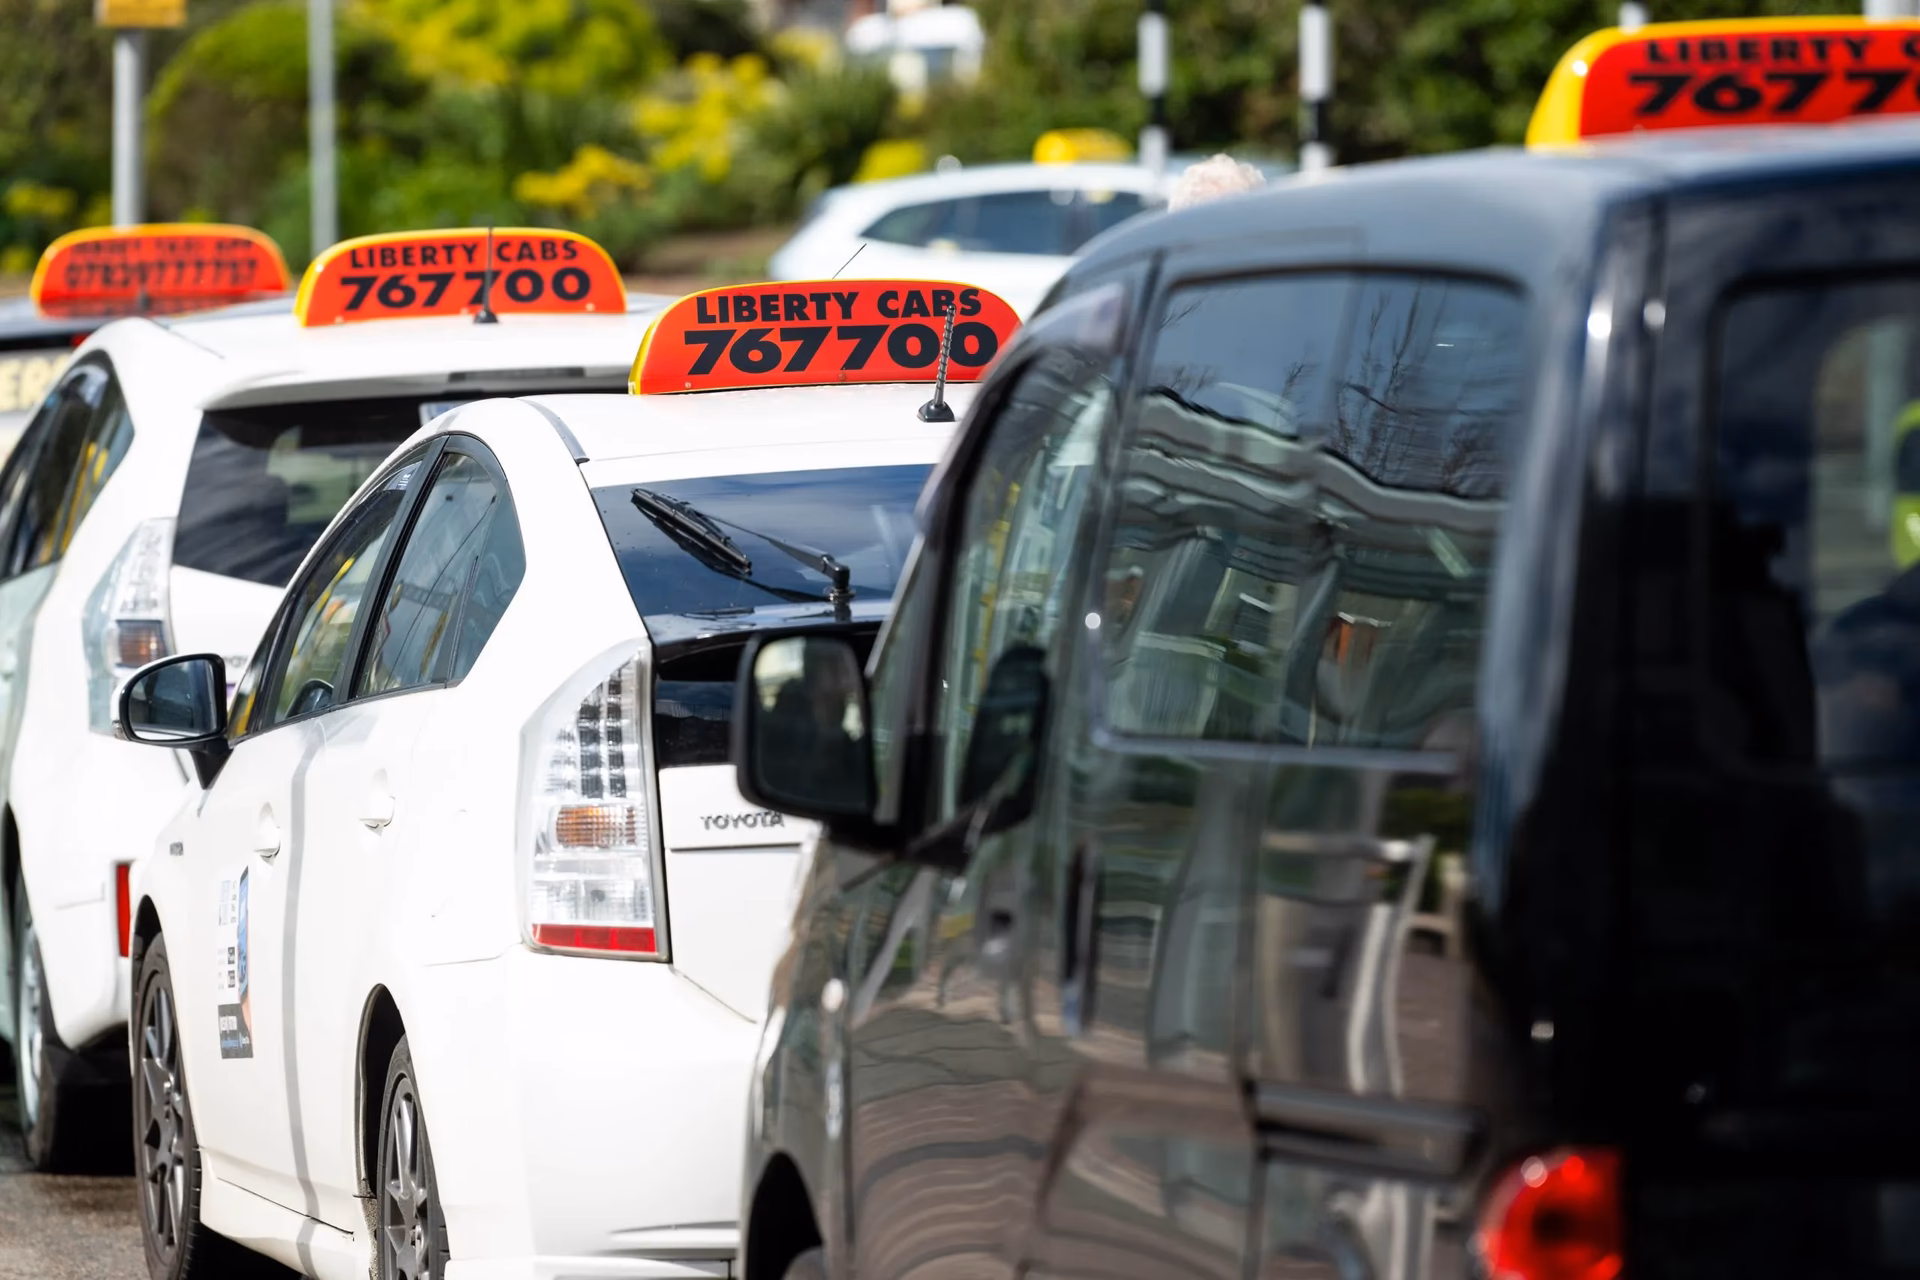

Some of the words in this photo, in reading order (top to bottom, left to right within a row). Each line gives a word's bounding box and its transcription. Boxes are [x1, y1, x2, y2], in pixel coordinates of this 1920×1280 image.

[1647, 37, 1871, 64] LIBERTY
[350, 243, 478, 269] LIBERTY
[495, 239, 579, 262] CABS
[697, 291, 859, 324] LIBERTY
[877, 288, 982, 318] CABS
[700, 810, 785, 830] TOYOTA
